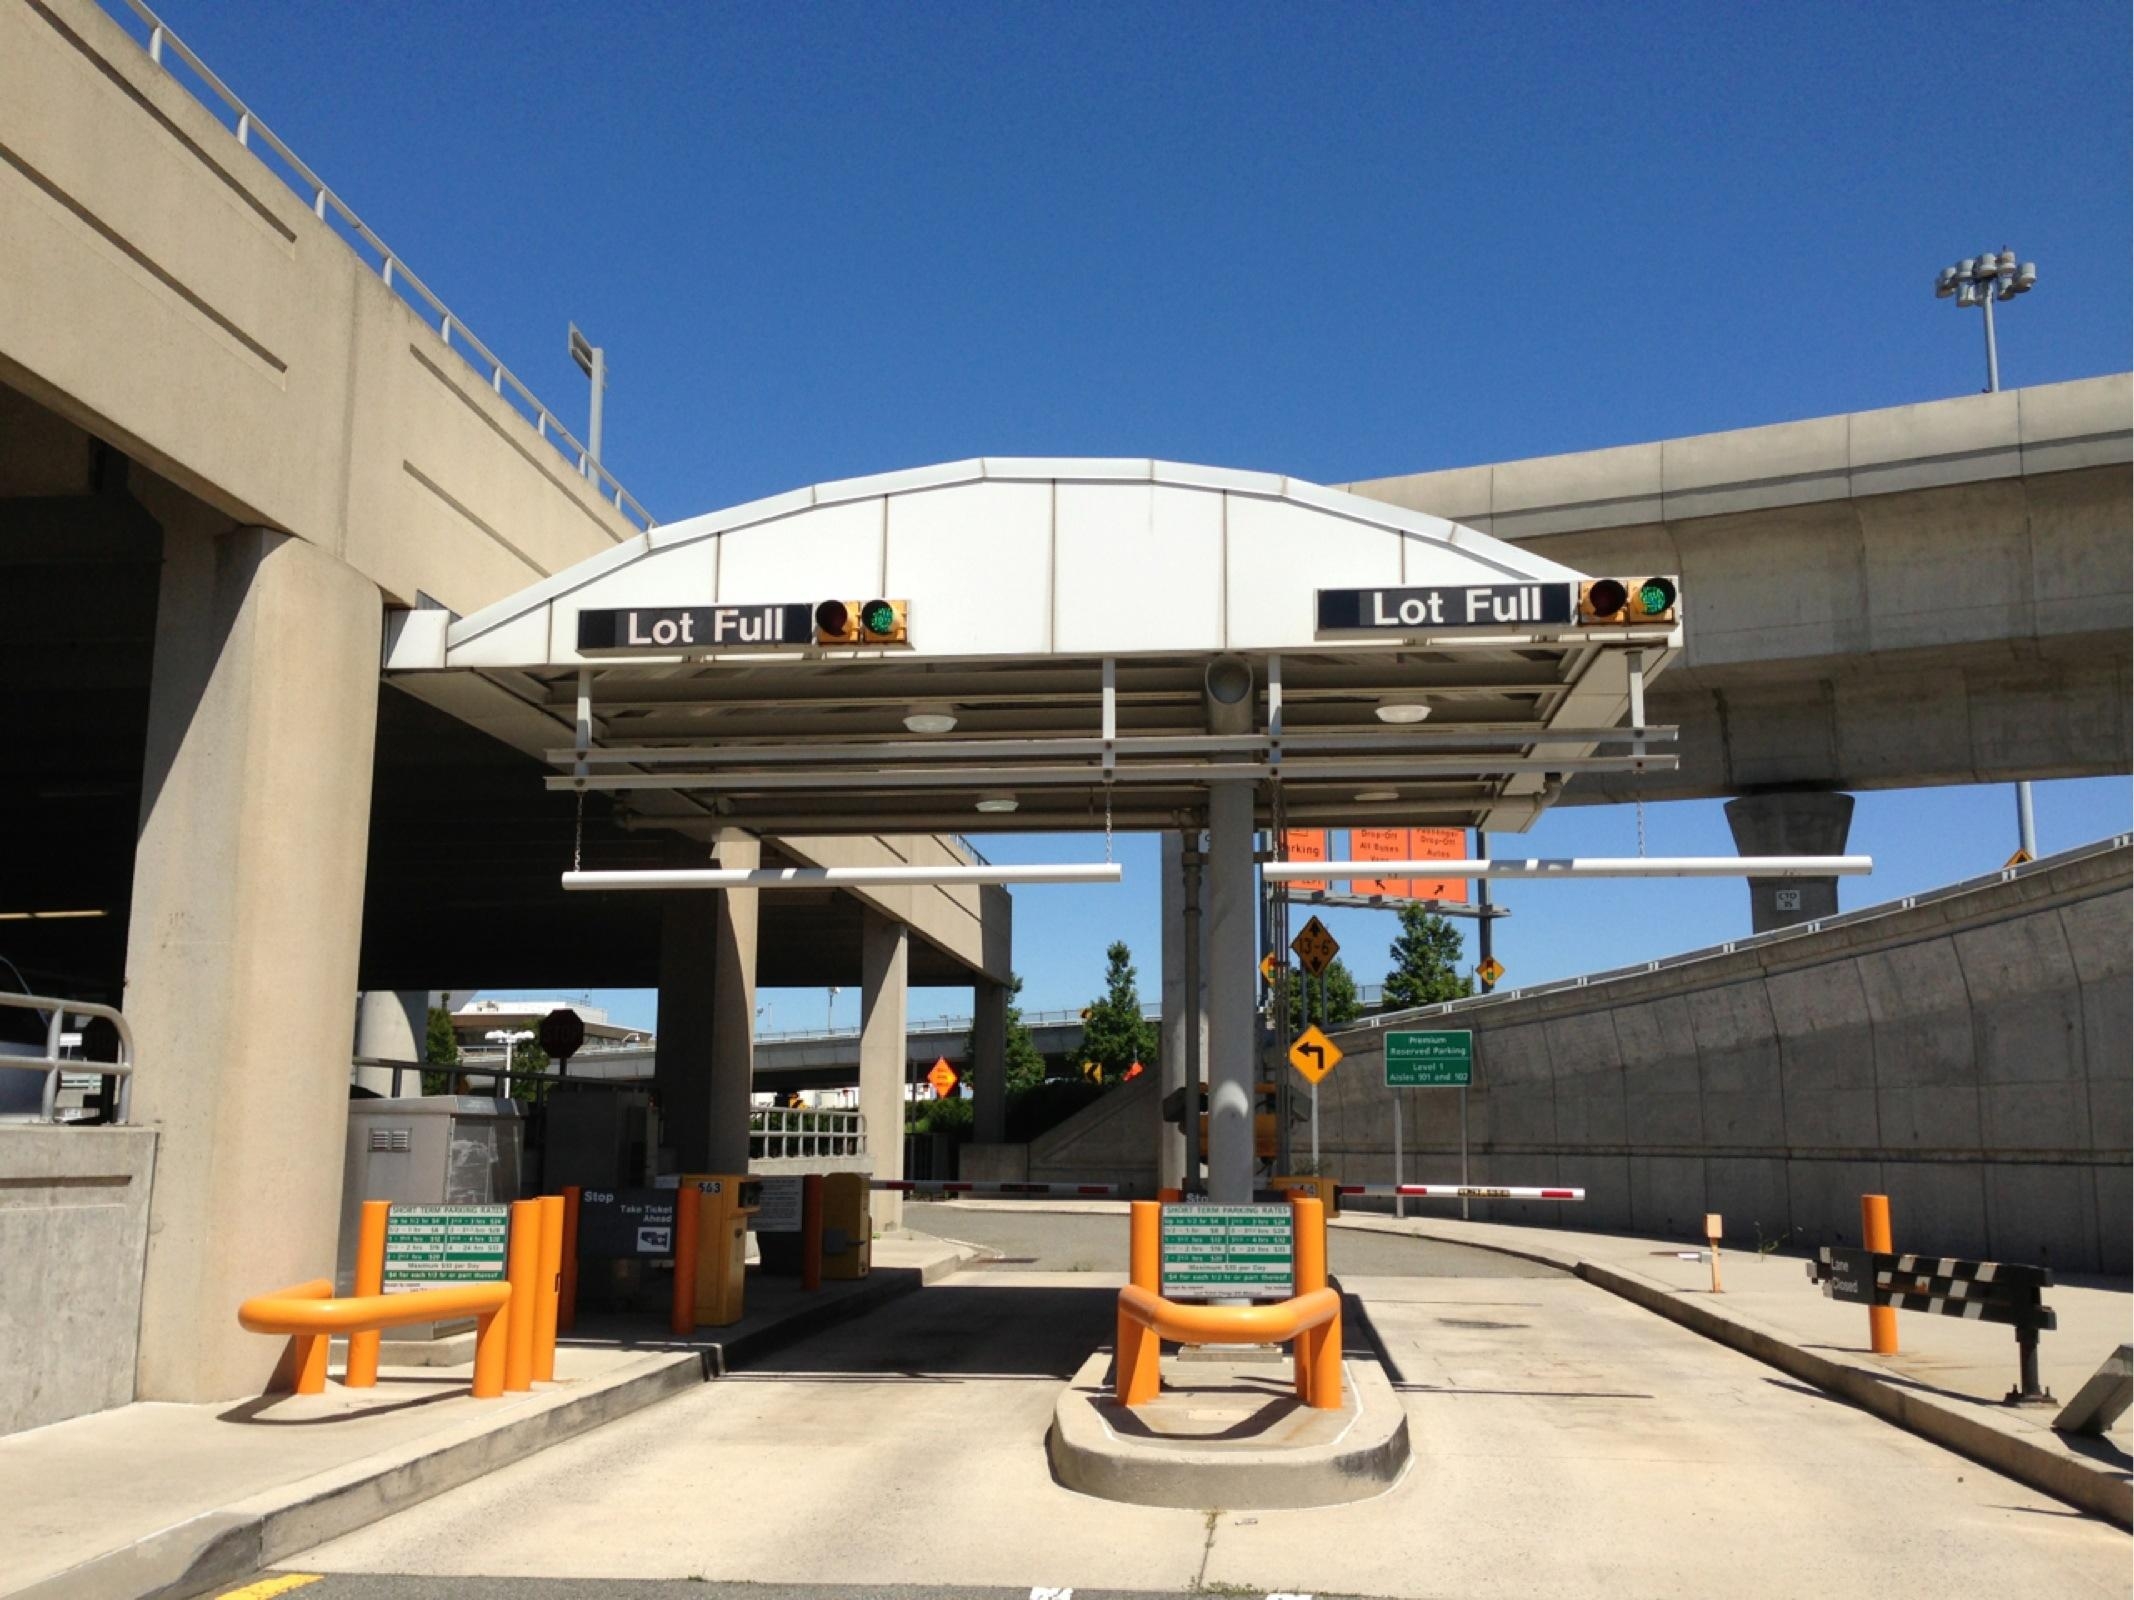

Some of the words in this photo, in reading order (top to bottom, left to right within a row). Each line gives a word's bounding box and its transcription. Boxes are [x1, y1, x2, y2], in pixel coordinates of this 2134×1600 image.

[1373, 592, 1444, 626] Lot
[1466, 586, 1542, 623] Full
[628, 611, 694, 645] Lot
[714, 607, 784, 642] Full
[1420, 835, 1456, 846] Drop-Off
[1279, 842, 1320, 857] rking
[1427, 848, 1451, 858] Autos
[1408, 1036, 1447, 1044] Premium
[1390, 1047, 1431, 1055] Reserved
[1433, 1047, 1466, 1056] Parking
[1412, 1062, 1436, 1071] Level
[1390, 1073, 1415, 1081] Aisles
[584, 1191, 614, 1204] Stop
[621, 1205, 642, 1213] Take
[645, 1205, 672, 1214] Ticket
[1831, 1257, 1849, 1272] Lane
[1832, 1277, 1858, 1294] Closed
